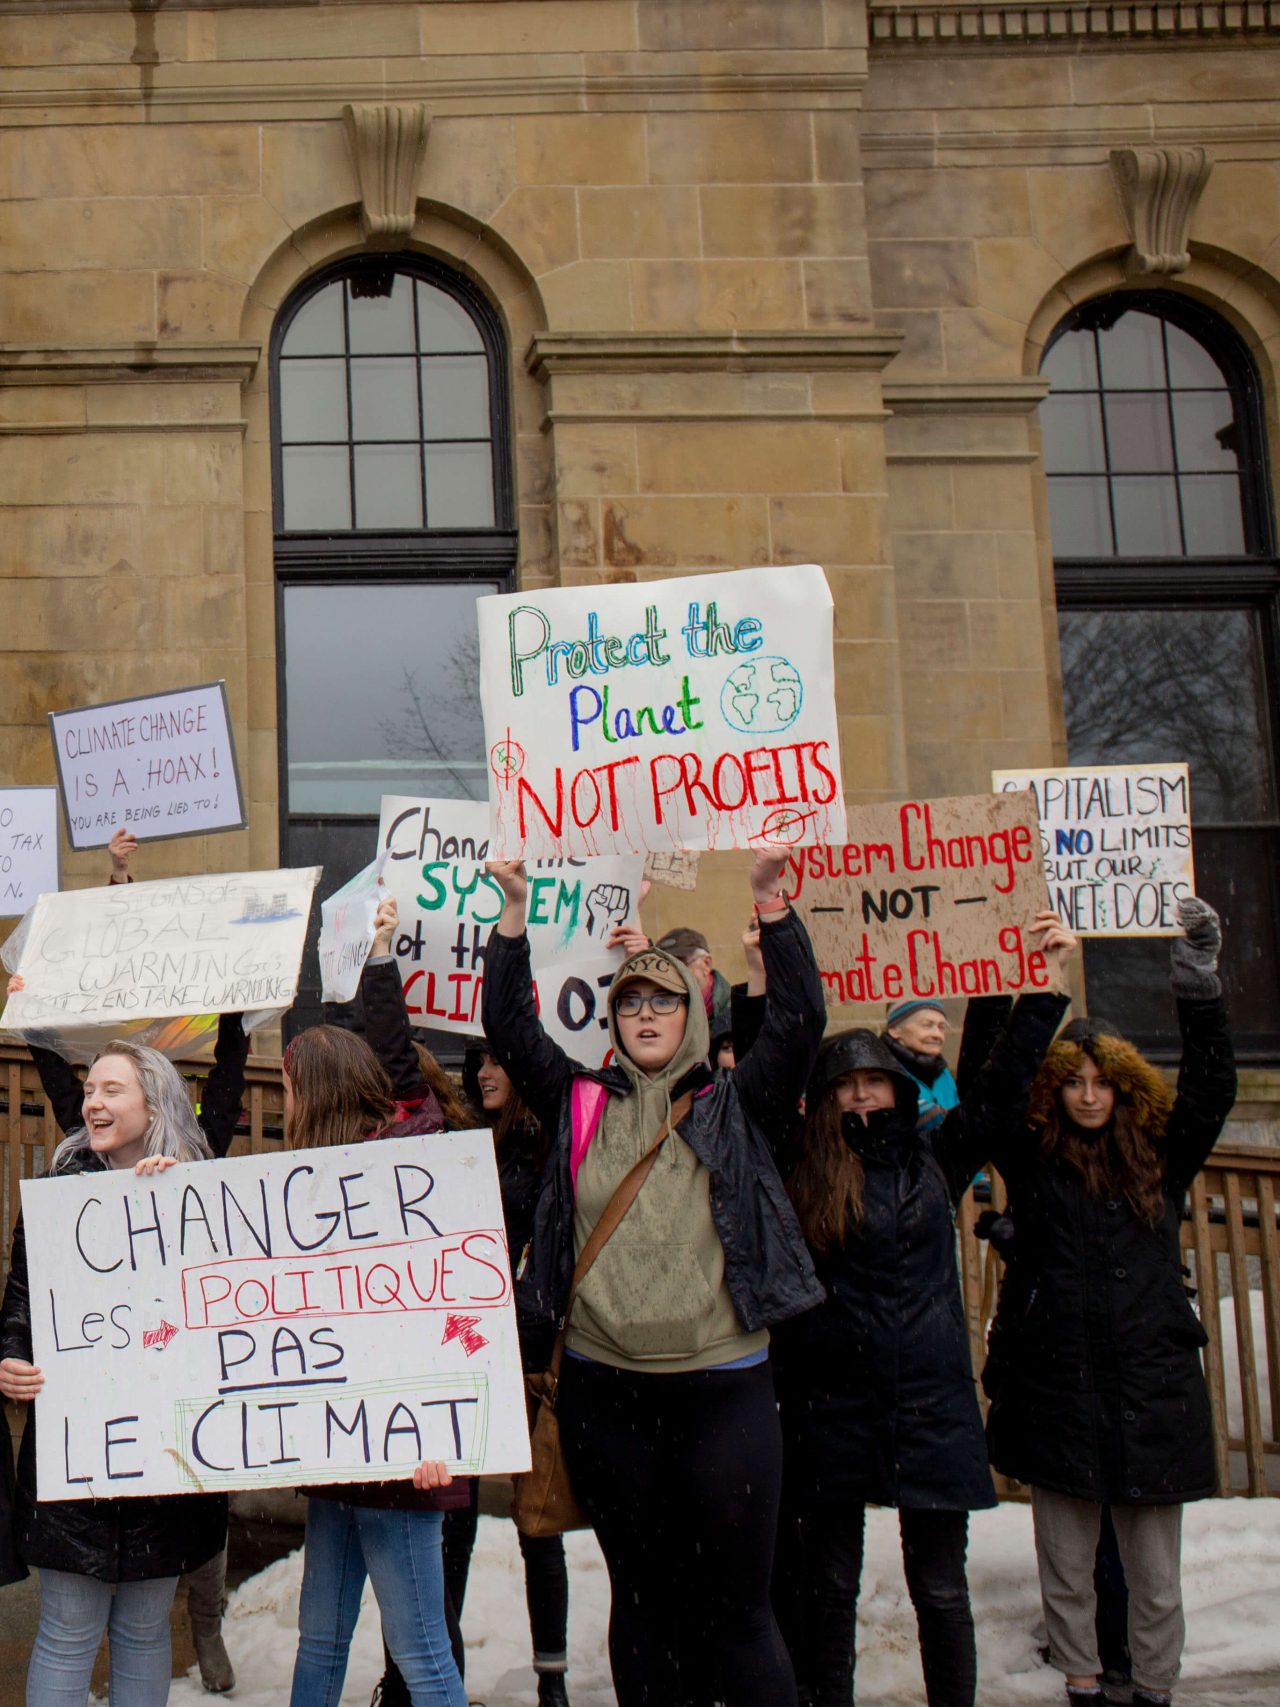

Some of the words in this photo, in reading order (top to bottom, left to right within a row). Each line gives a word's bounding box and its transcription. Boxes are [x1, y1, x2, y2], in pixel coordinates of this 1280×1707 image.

[508, 605, 670, 697] Protect
[682, 602, 763, 658] the
[65, 716, 136, 760] CLIMATE
[139, 704, 208, 742] CHANGE
[569, 675, 704, 751] Planet
[75, 773, 99, 801] IS
[112, 768, 131, 797] A
[518, 756, 640, 838] NOT
[649, 741, 837, 824] PROFITS
[10, 833, 44, 851] TAX
[71, 817, 92, 831] YOU
[96, 812, 117, 827] ARE
[125, 805, 161, 822] BEING
[167, 801, 189, 816] LIED
[1055, 829, 1094, 855] NO
[1101, 825, 1190, 852] LIMITS
[900, 802, 1032, 894] Change
[1095, 855, 1146, 879] OUR
[861, 885, 941, 924] NOT
[41, 912, 230, 964] GLOBAL
[907, 925, 1049, 999] Change
[626, 958, 670, 975] NYC
[75, 1164, 444, 1274] CHANGER
[49, 1288, 132, 1352] Les
[199, 1233, 507, 1325] POLITIQUES
[219, 1326, 346, 1381] PAS
[64, 1415, 144, 1484] LE
[191, 1398, 479, 1472] CLIMAT
